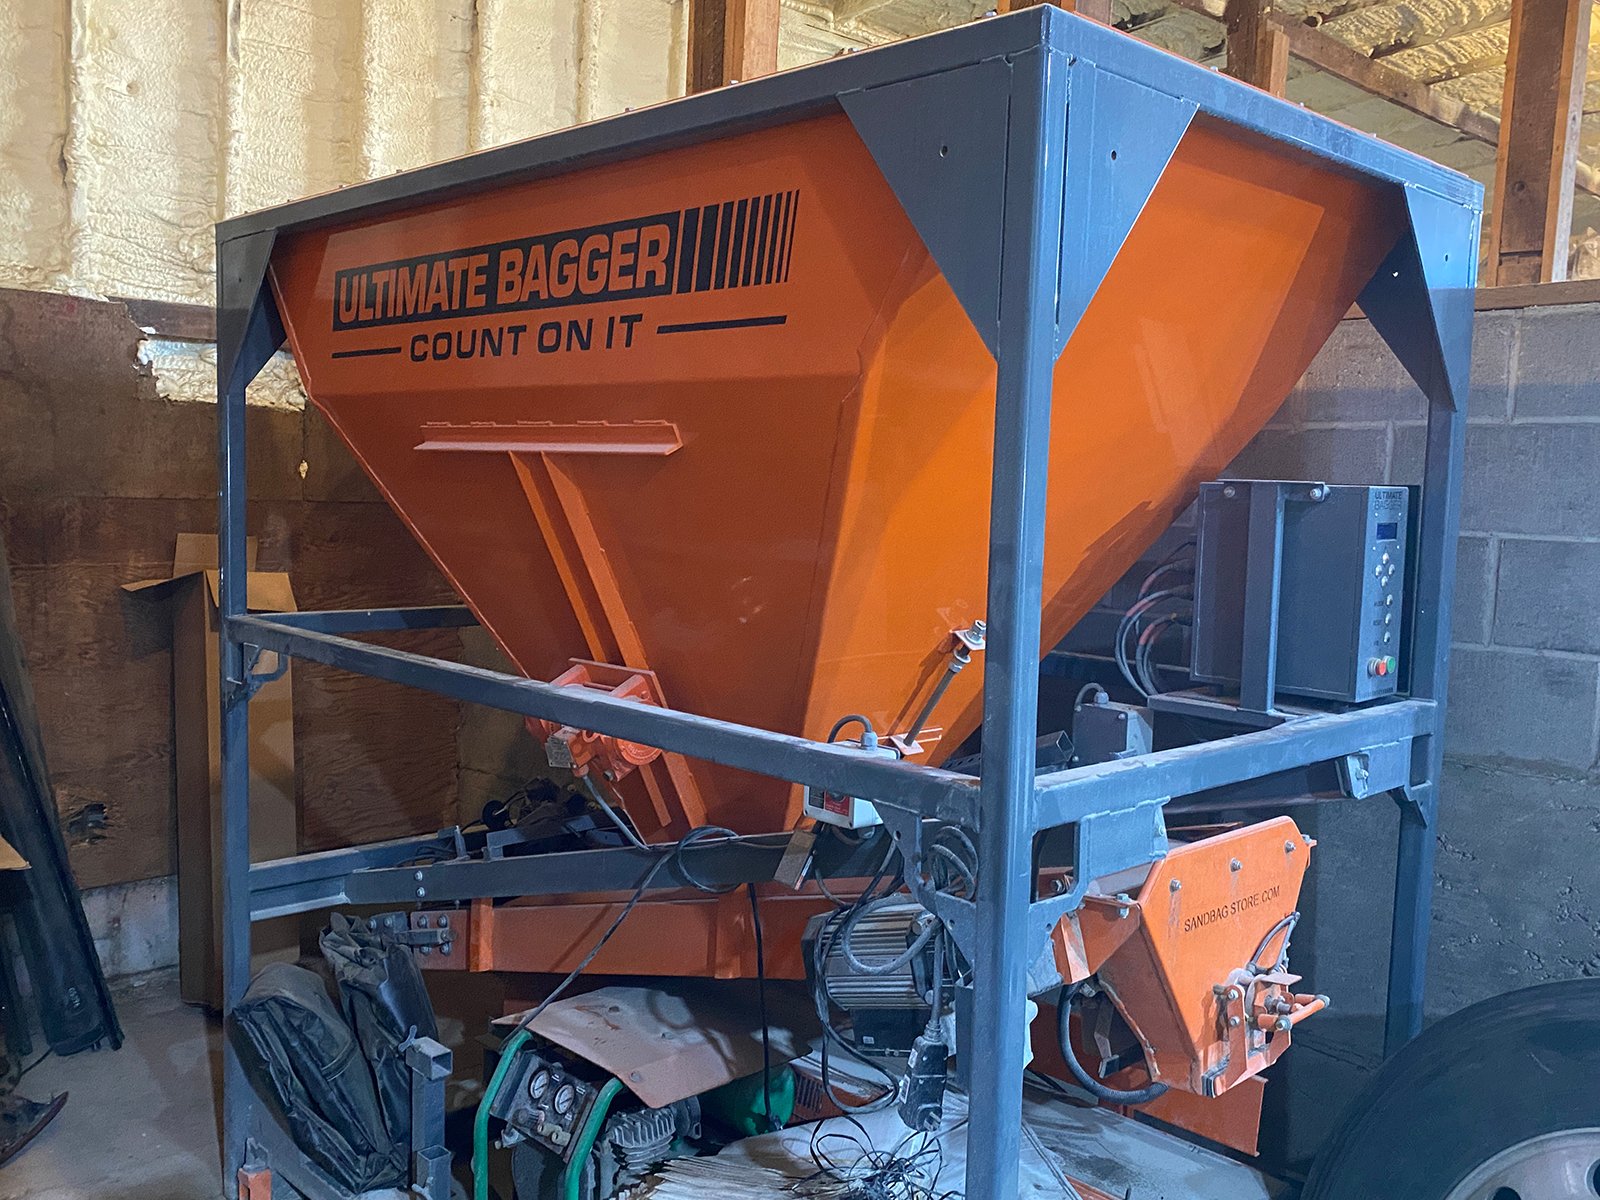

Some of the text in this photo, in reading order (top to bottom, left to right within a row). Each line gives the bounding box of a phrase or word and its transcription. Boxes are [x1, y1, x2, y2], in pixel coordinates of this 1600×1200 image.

[338, 224, 670, 324] ULTIMATE BAGGER
[410, 314, 643, 362] COUNT ON IT
[1184, 905, 1229, 932] SANDBAG
